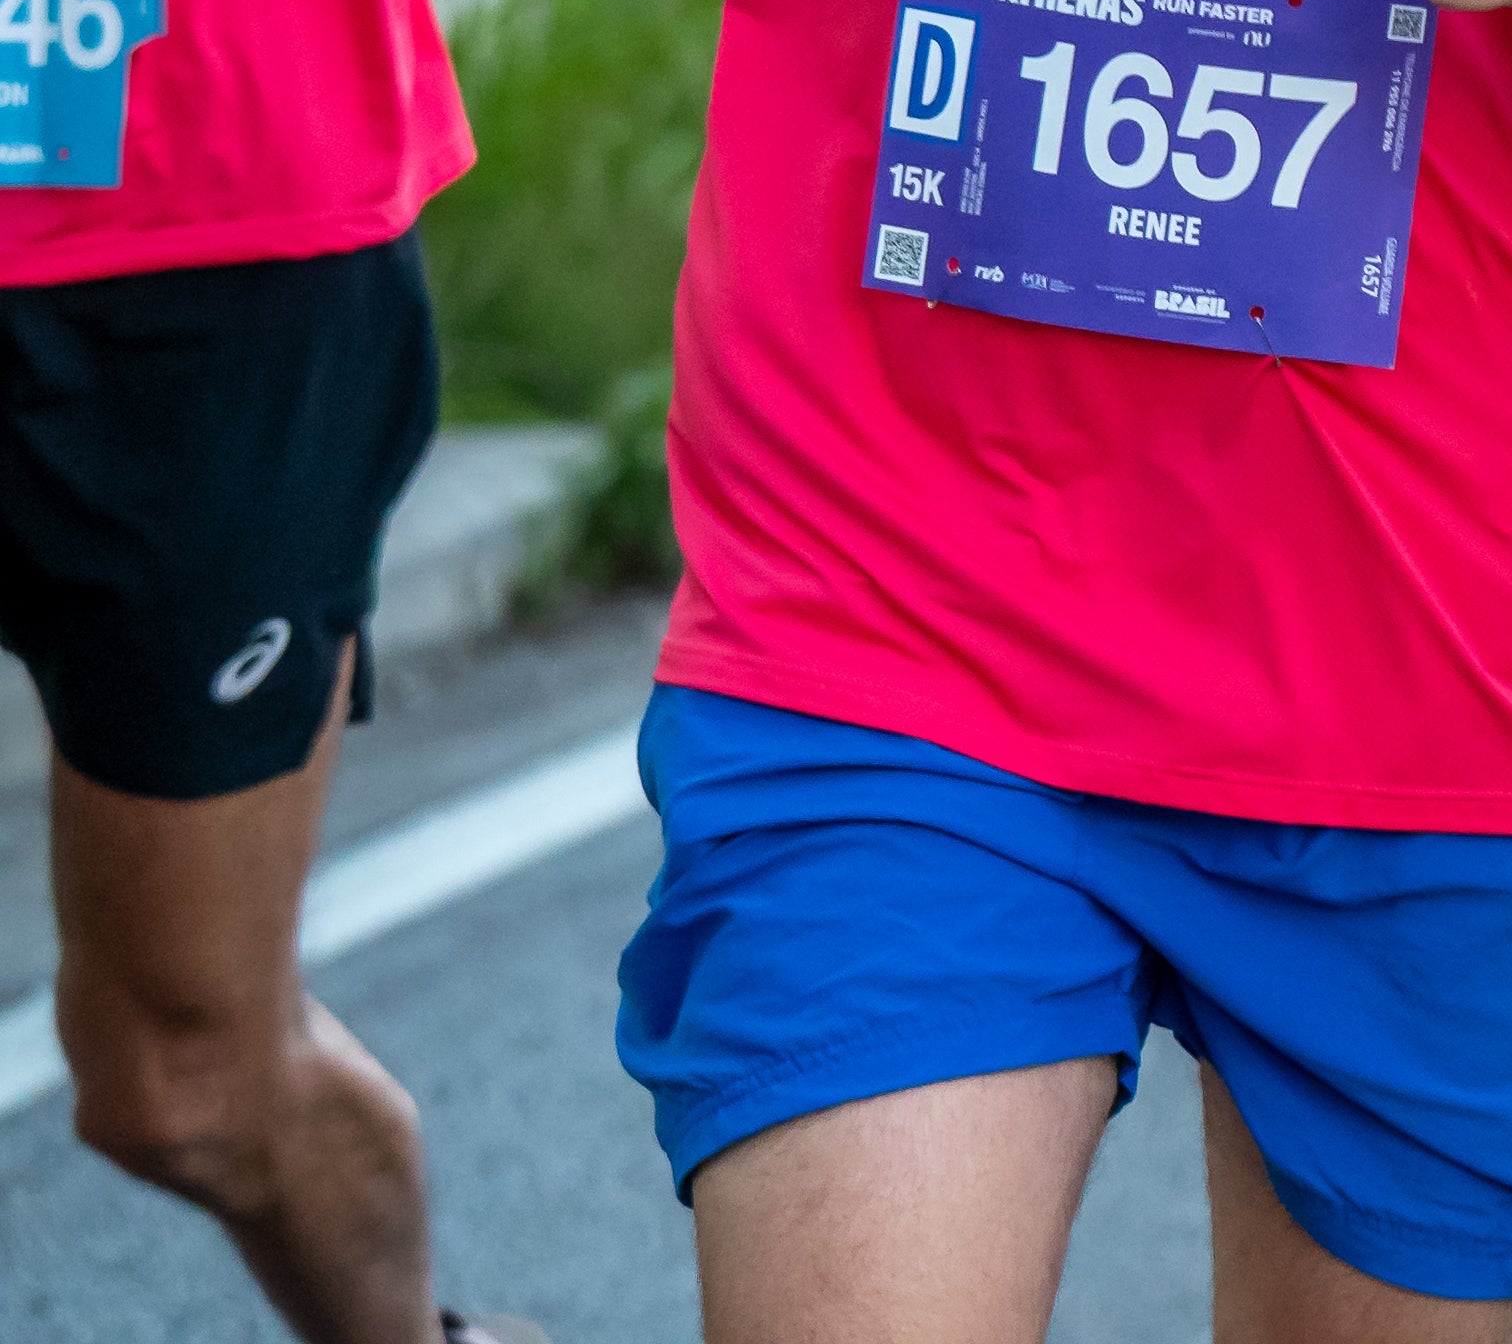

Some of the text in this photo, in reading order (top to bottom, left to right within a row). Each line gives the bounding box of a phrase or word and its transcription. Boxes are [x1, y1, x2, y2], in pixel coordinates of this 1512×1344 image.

[1199, 0, 1275, 26] FASTER
[908, 22, 957, 120] D
[1020, 42, 1358, 210] 1657
[889, 163, 944, 206] 15K
[1108, 205, 1202, 246] RENEE
[1361, 254, 1382, 298] 1657
